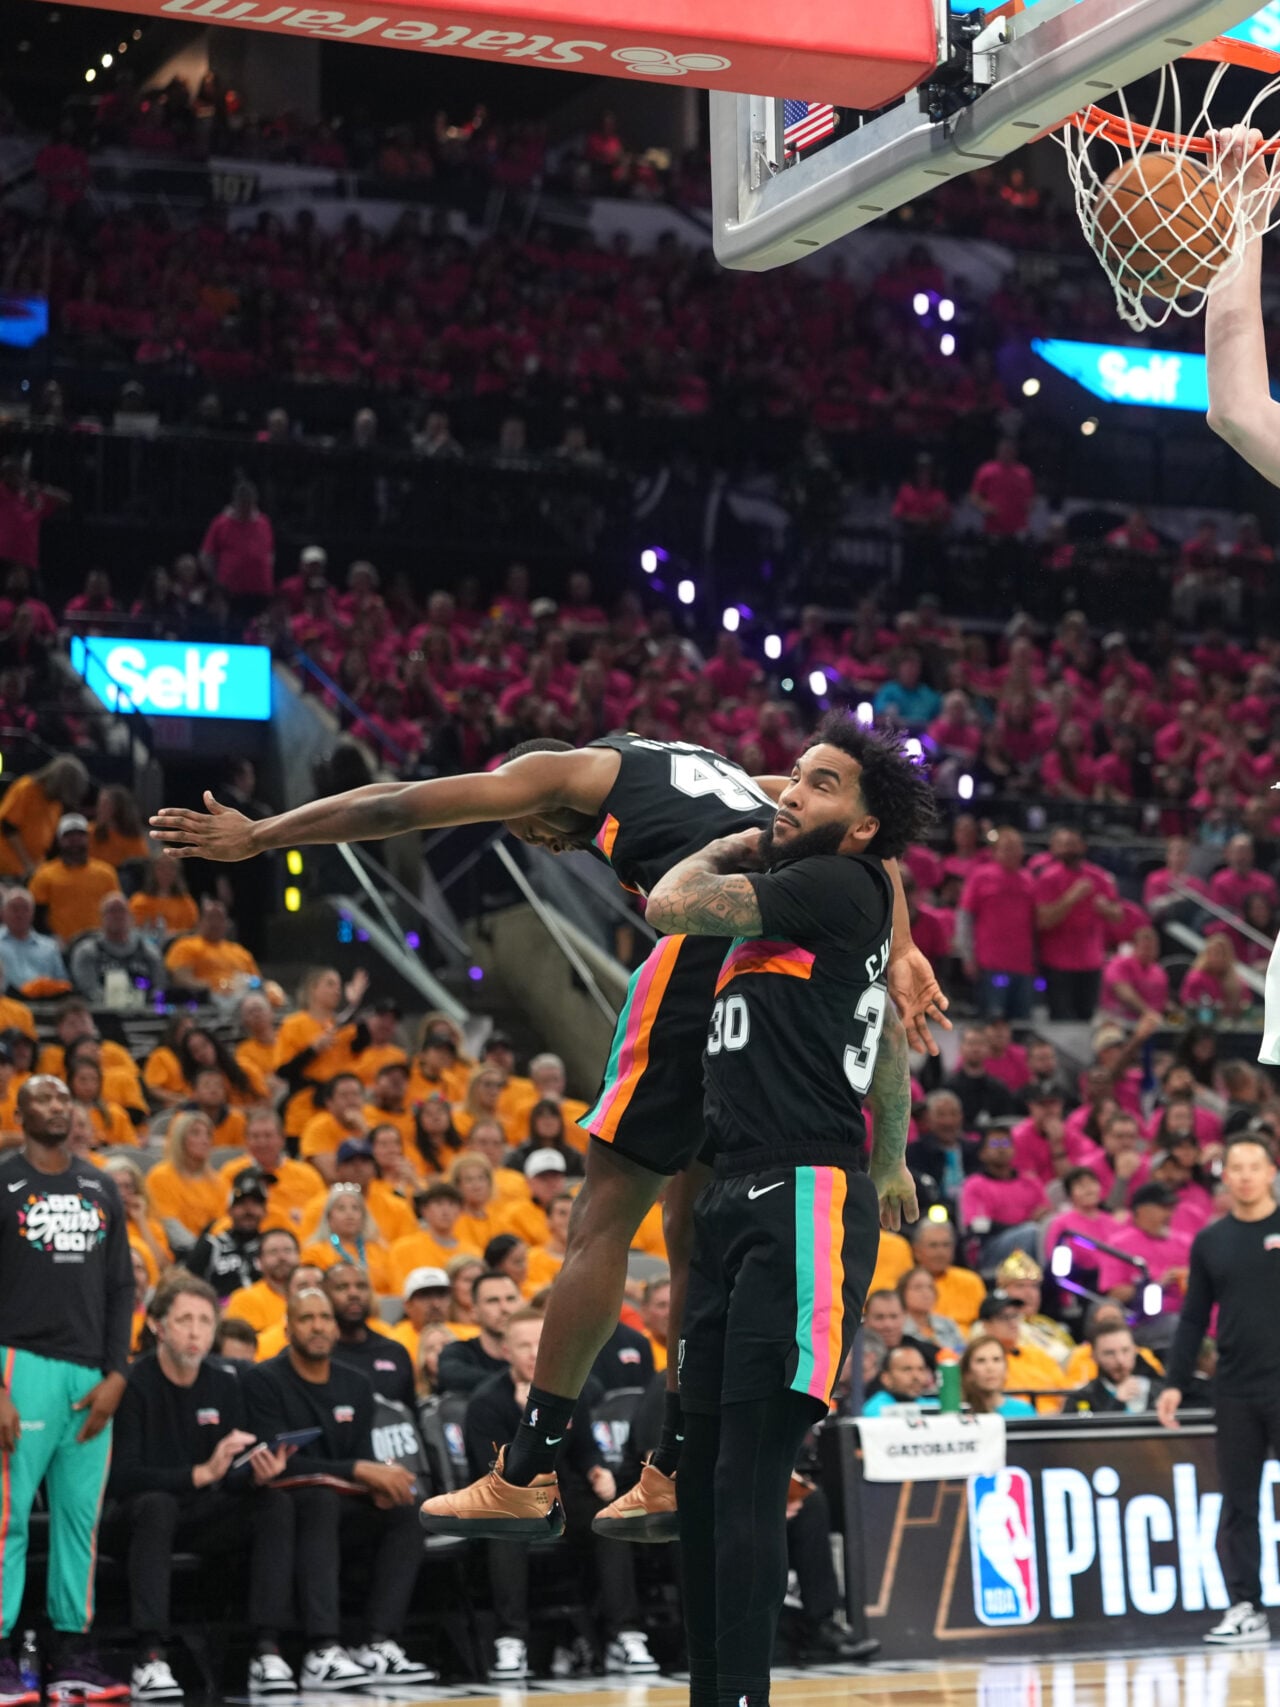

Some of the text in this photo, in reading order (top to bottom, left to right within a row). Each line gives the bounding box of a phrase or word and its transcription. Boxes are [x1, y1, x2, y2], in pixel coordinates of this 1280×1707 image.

[1098, 351, 1182, 402] Self
[106, 646, 229, 711] Self
[707, 994, 749, 1056] 30
[26, 1200, 100, 1243] Spurs
[47, 1194, 81, 1213] GO
[54, 1232, 86, 1251] GO
[887, 1441, 979, 1458] GATORADE
[1042, 1463, 1231, 1619] Pick
